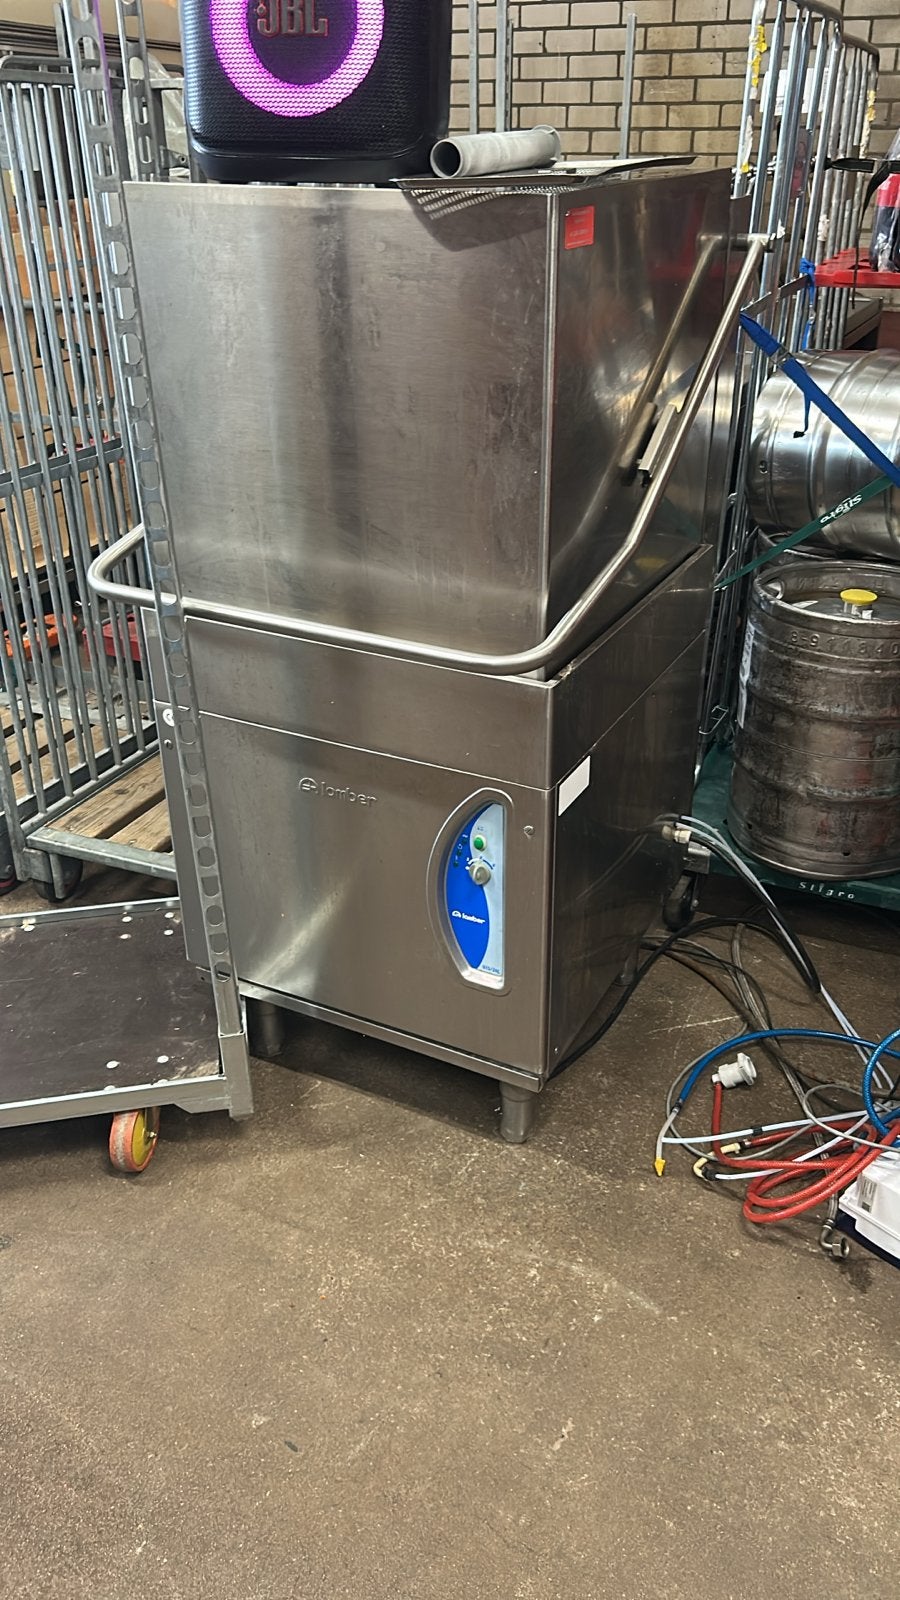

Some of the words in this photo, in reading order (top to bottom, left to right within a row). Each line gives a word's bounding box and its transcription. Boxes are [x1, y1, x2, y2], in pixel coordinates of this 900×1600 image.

[257, 0, 328, 37] JBL
[820, 494, 862, 523] Sligro
[799, 881, 855, 899] Sligro
